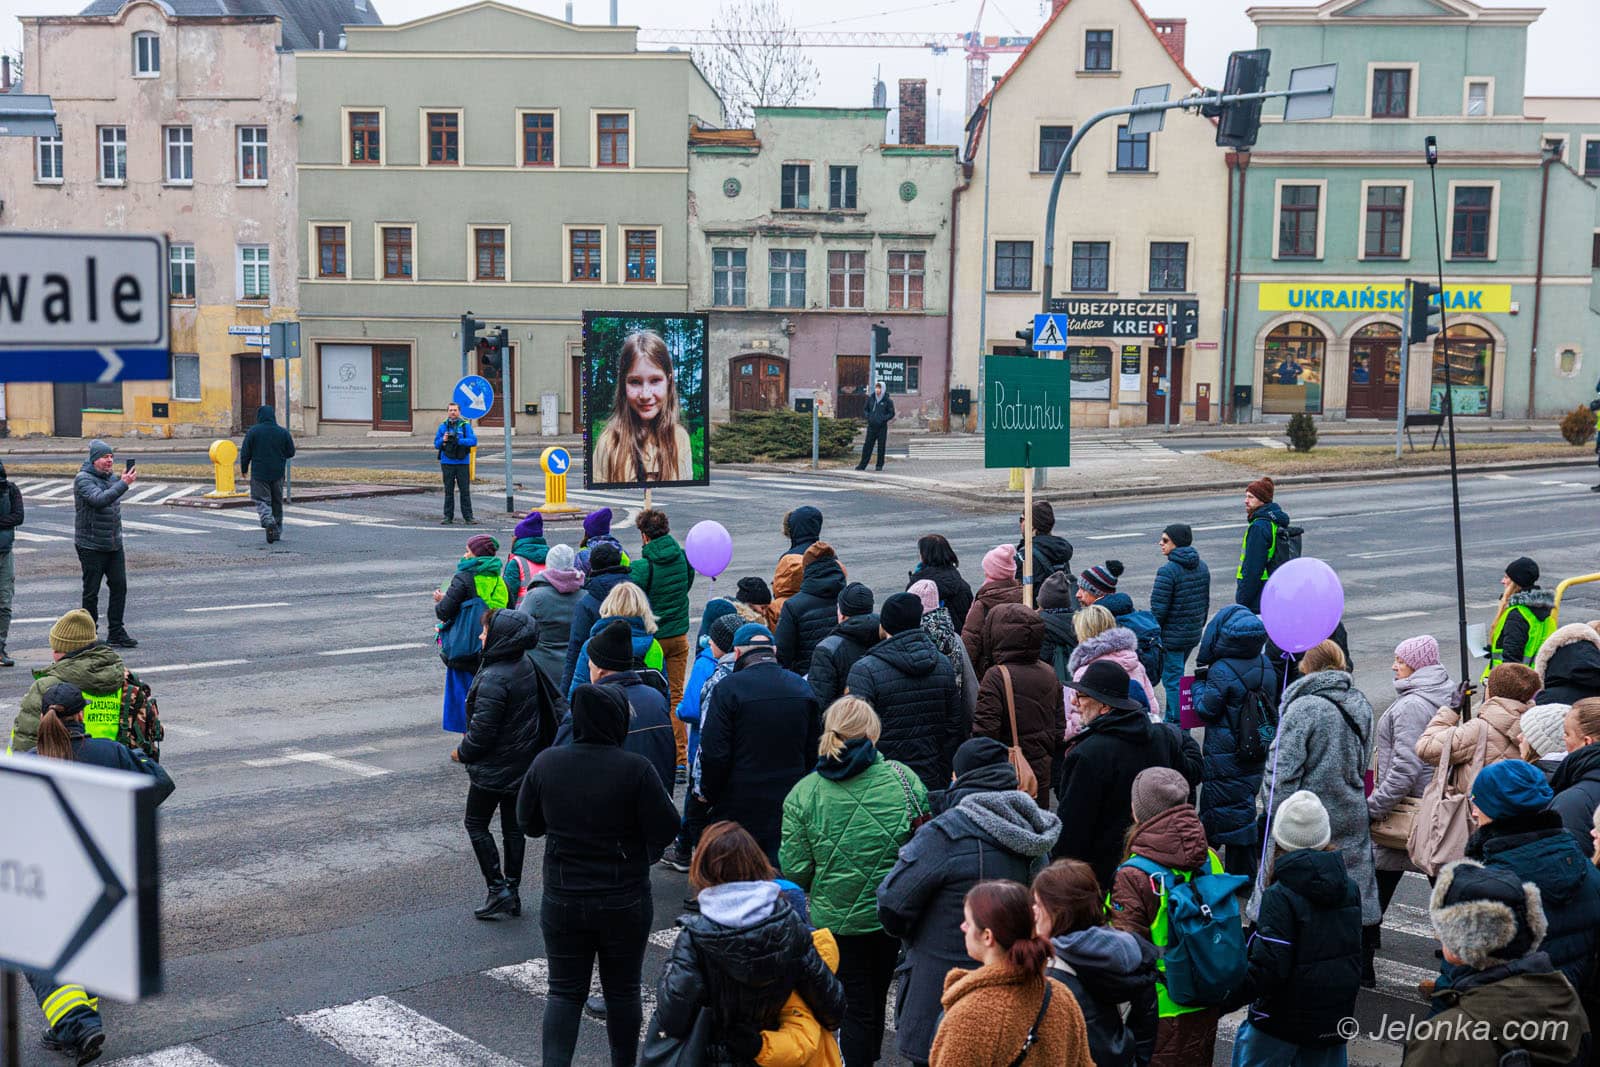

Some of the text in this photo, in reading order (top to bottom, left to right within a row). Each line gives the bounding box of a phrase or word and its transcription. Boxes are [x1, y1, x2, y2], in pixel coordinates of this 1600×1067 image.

[1288, 286, 1482, 309] UKRAIŃSK MAK
[992, 381, 1064, 430] Ratunku
